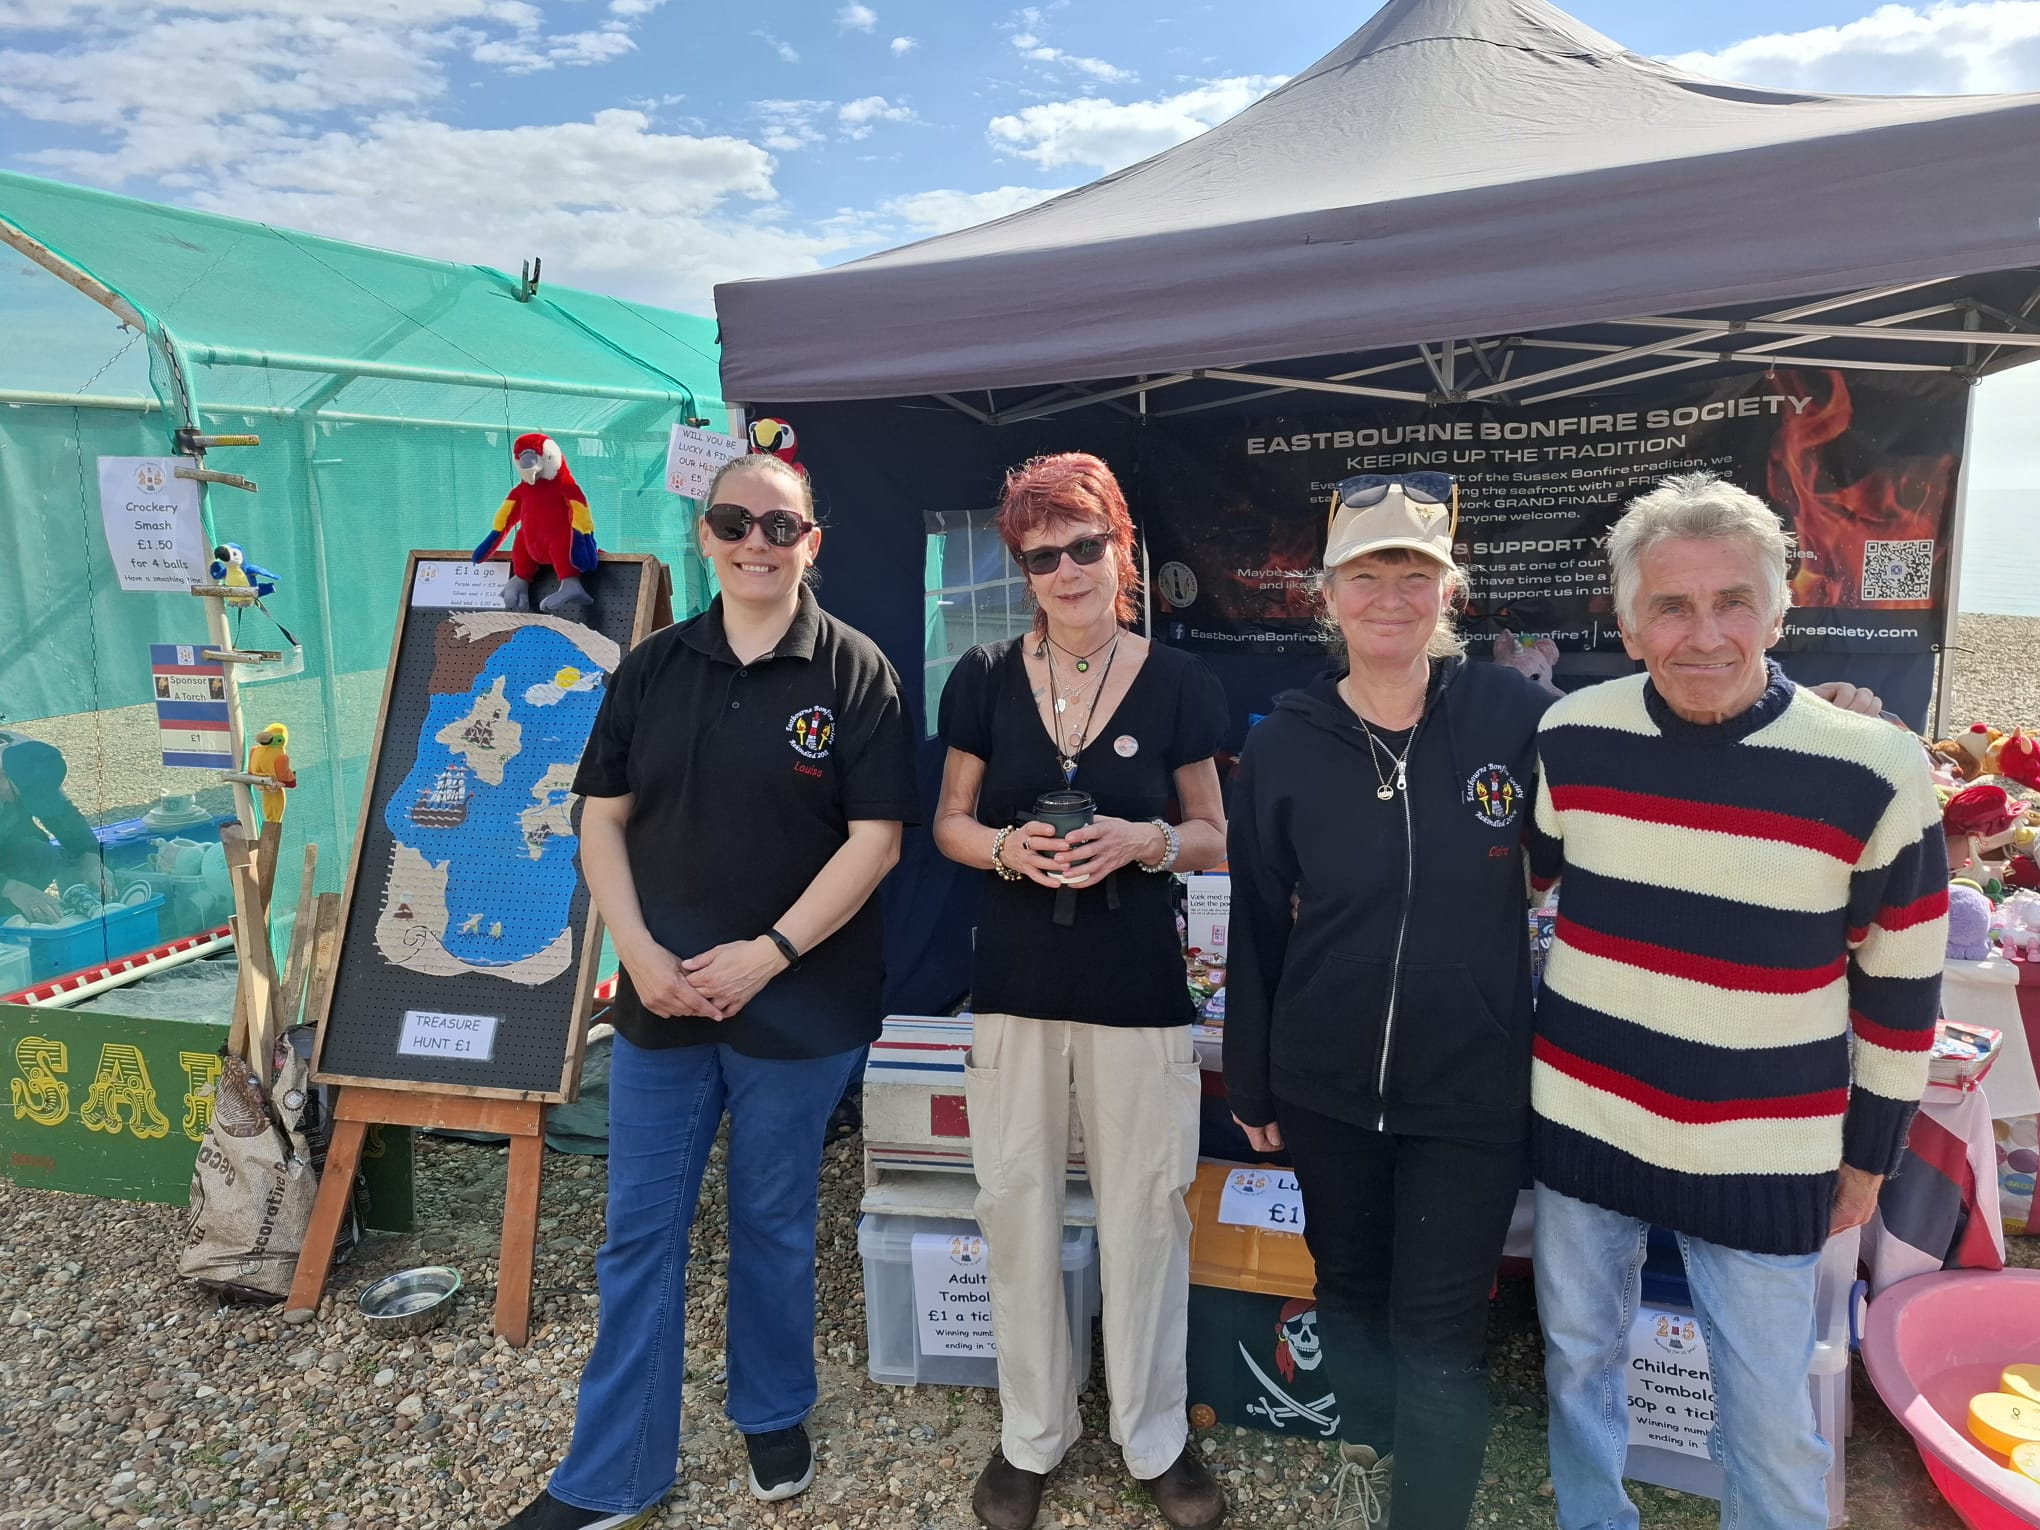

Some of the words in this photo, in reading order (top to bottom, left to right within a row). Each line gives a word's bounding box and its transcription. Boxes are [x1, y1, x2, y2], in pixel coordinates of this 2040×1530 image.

[1247, 423, 1473, 455] EASTBOURNE
[1480, 412, 1638, 441] BONFIRE
[1646, 396, 1814, 428] SOCIETY
[682, 429, 703, 442] WILL
[706, 434, 723, 446] YOU
[726, 441, 737, 450] BE
[678, 442, 703, 455] LUCKY
[705, 450, 712, 458] &
[1346, 451, 1448, 470] KEEPING
[1453, 450, 1486, 464] UP
[1490, 449, 1538, 463] THE
[1542, 434, 1686, 461] TRADITION
[679, 457, 696, 468] OUR
[1310, 481, 1337, 491] Eve
[1468, 473, 1483, 482] of
[1486, 473, 1510, 482] the
[1512, 471, 1568, 482] Sussex
[1571, 465, 1630, 479] Bonfire
[1633, 458, 1707, 472] tradition,
[1711, 455, 1733, 465] we
[1482, 486, 1507, 496] the
[1510, 484, 1576, 495] seafront
[1578, 480, 1612, 492] with
[1615, 480, 1624, 489] a
[1494, 498, 1555, 509] GRAND
[1558, 492, 1622, 505] FINALE.
[125, 502, 178, 516] Crockery
[1457, 514, 1507, 525] eryone
[1510, 511, 1581, 521] welcome.
[134, 520, 172, 531] Smash
[137, 540, 173, 550] £1.50
[1454, 543, 1468, 555] S
[1473, 538, 1587, 555] SUPPORT
[1591, 537, 1608, 549] Y
[131, 558, 148, 569] for
[152, 559, 160, 568] 4
[163, 560, 189, 569] balls
[1489, 564, 1507, 572] us
[1509, 563, 1526, 571] at
[1529, 562, 1557, 571] one
[1560, 559, 1576, 569] of
[1578, 559, 1606, 568] our
[455, 565, 468, 576] £1
[483, 569, 495, 578] go
[1259, 580, 1284, 590] and
[1480, 576, 1515, 586] have
[1518, 575, 1552, 585] time
[1554, 574, 1572, 583] to
[1575, 573, 1594, 582] be
[1597, 573, 1607, 581] a
[1489, 589, 1552, 601] support
[1554, 588, 1573, 597] us
[1576, 586, 1589, 595] in
[1191, 628, 1345, 642] EastbourneBonfireSoc
[1780, 624, 1918, 640] firesociety.com
[170, 676, 207, 687] Sponsor
[174, 692, 180, 700] A
[182, 692, 206, 701] Torch
[191, 734, 200, 743] £1
[416, 1015, 481, 1032] TREASURE
[413, 1036, 450, 1049] HUNT
[455, 1040, 471, 1052] £1
[1277, 1178, 1301, 1191] Lu
[247, 1176, 286, 1256] ecorative
[1268, 1203, 1299, 1224] £1
[948, 1273, 988, 1285] Adult
[938, 1291, 991, 1303] Tombol
[928, 1309, 948, 1322] £1
[955, 1313, 965, 1322] a
[970, 1309, 992, 1322] tic
[935, 1329, 969, 1338] Winning
[945, 1342, 973, 1351] ending
[976, 1342, 984, 1350] in
[1665, 1404, 1676, 1415] a
[1635, 1416, 1680, 1433] Winning
[1648, 1433, 1684, 1447] ending
[1688, 1439, 1699, 1449] in
